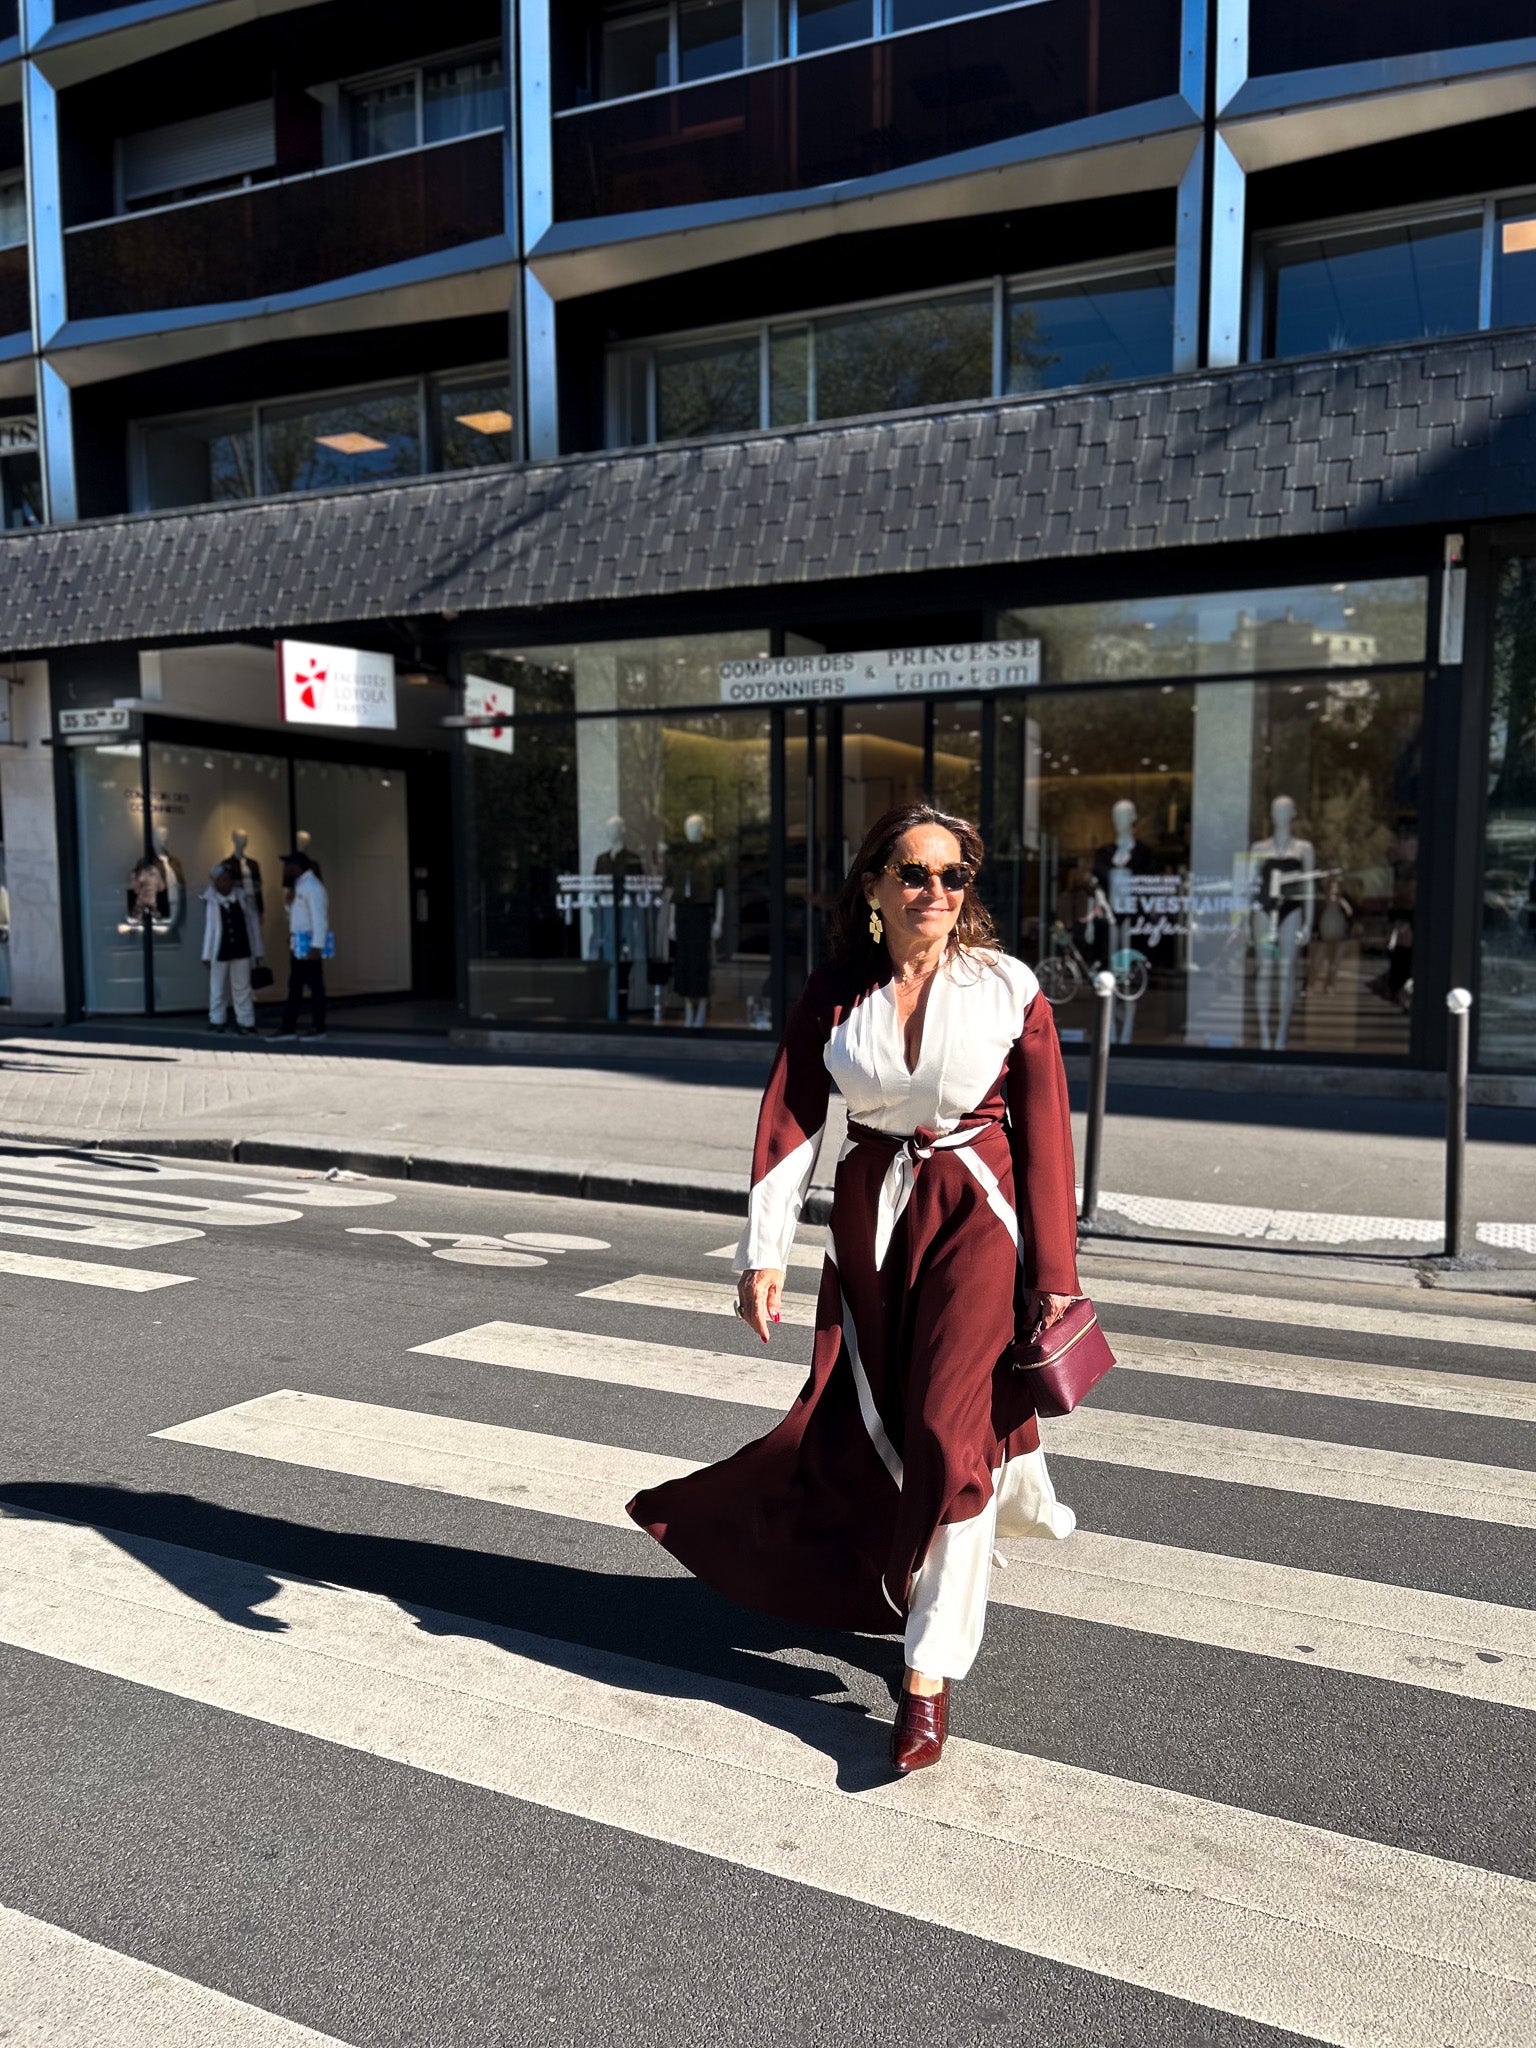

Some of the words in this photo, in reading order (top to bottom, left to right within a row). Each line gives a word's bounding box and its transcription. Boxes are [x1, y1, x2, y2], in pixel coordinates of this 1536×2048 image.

[887, 638, 1036, 667] PRINCESSE
[719, 657, 814, 680] COMPTOIR
[819, 654, 855, 674] DES
[864, 665, 876, 680] &
[729, 676, 846, 700] COTONNIERS
[1114, 897, 1138, 913] LE
